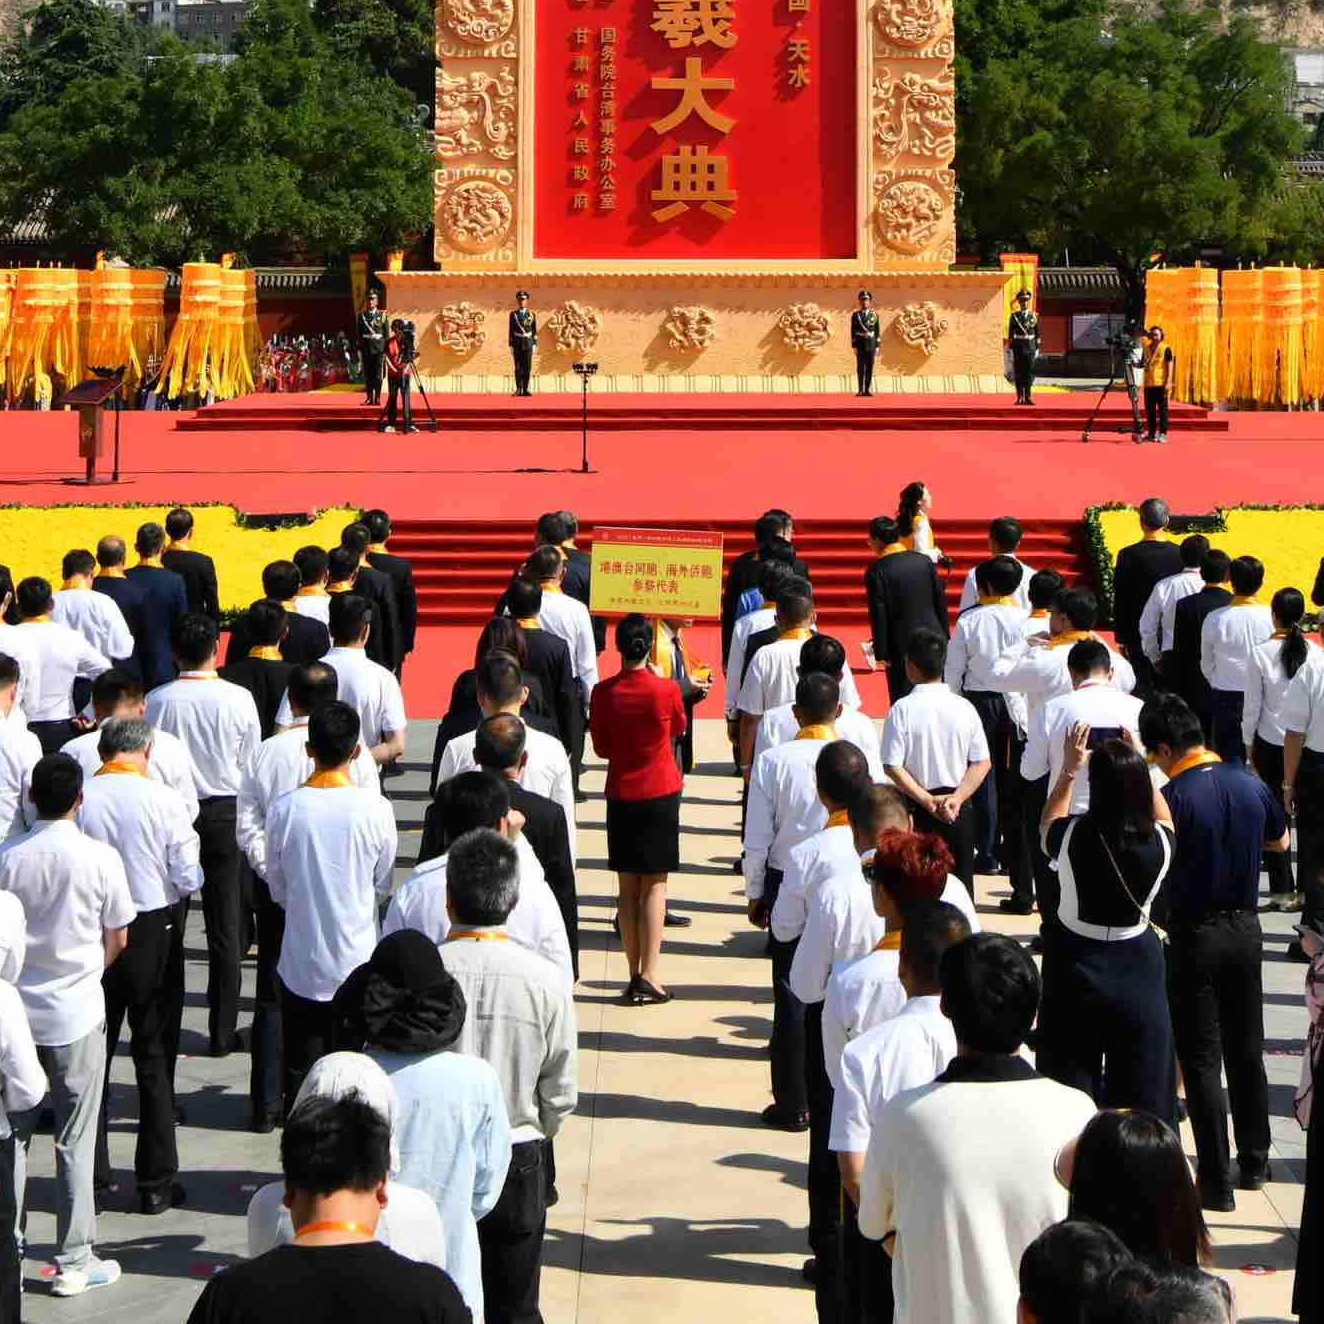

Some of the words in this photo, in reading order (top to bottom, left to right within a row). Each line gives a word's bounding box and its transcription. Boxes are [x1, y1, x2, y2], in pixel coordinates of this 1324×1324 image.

[573, 27, 589, 210] 甘肃省人民政府
